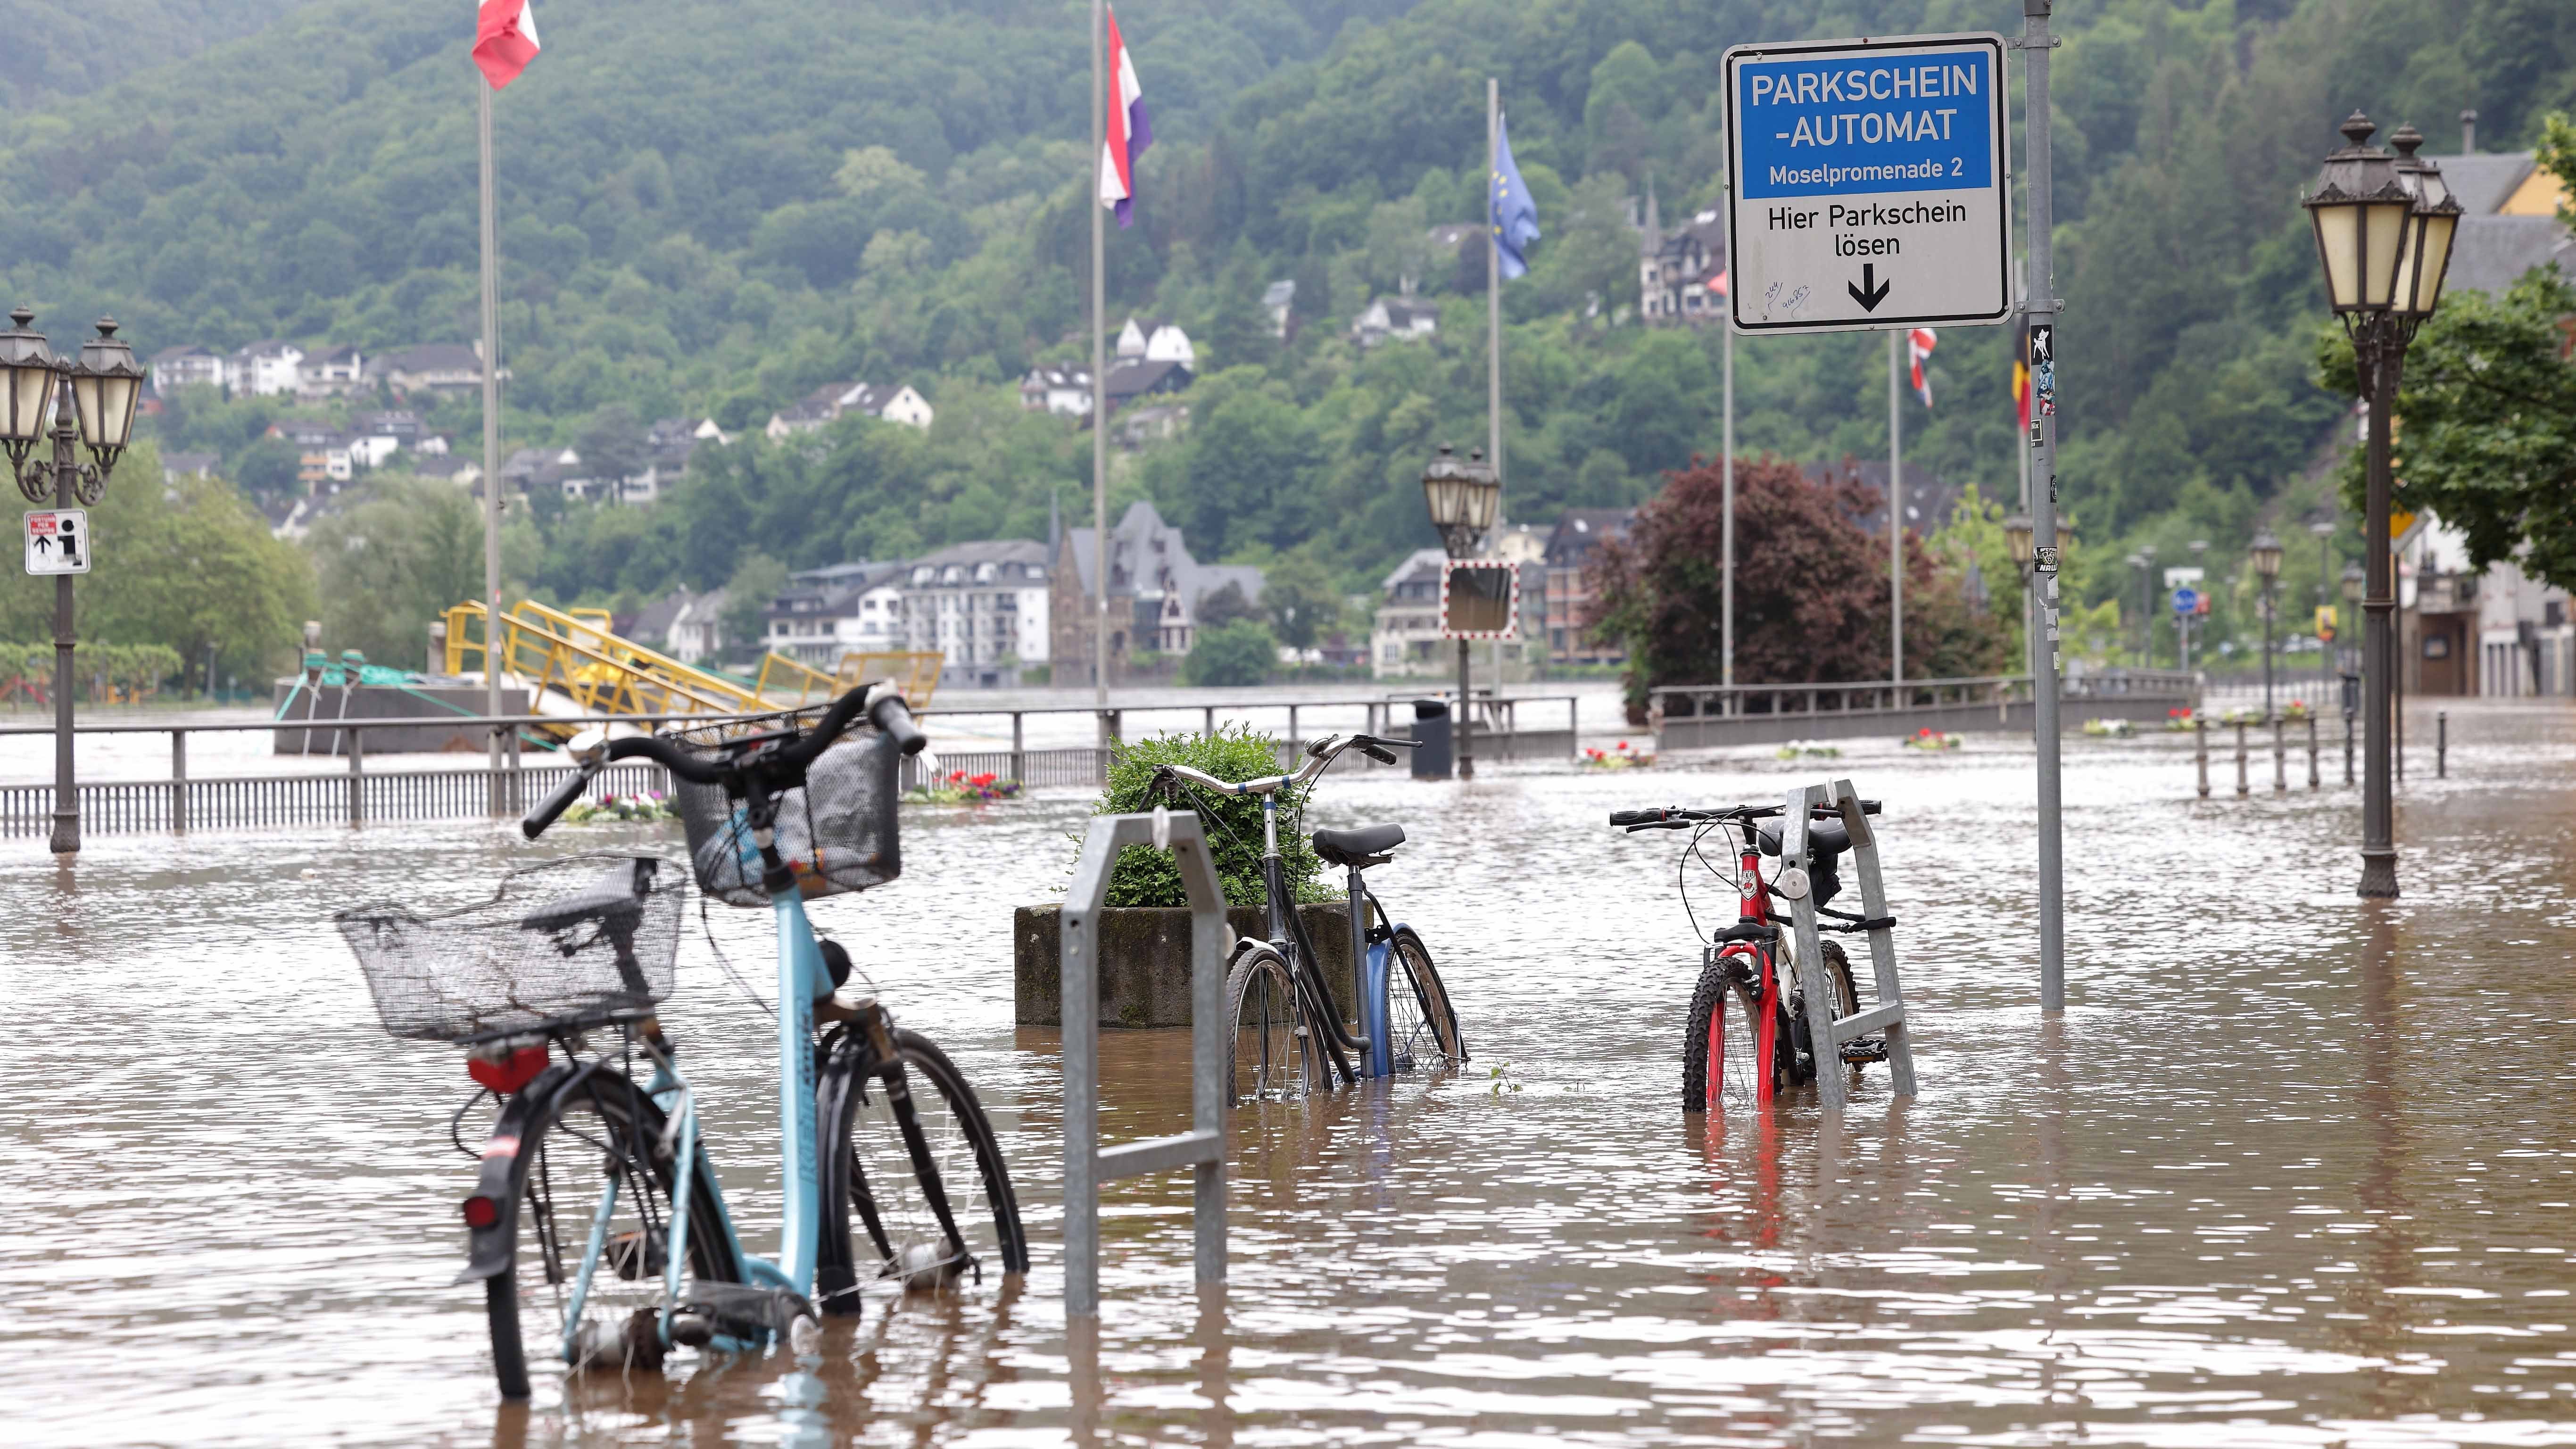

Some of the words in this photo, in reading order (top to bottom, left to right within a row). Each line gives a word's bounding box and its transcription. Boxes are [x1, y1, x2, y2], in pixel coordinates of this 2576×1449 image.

[1752, 64, 1977, 107] PARKSCHEIN
[1775, 108, 1957, 147] -AUTOMAT
[1770, 158, 1944, 187] Moselpromenade
[1951, 157, 1963, 177] 2
[1769, 207, 1819, 230] Hier
[1830, 199, 1966, 227] Parkschein
[1835, 233, 1900, 257] lösen
